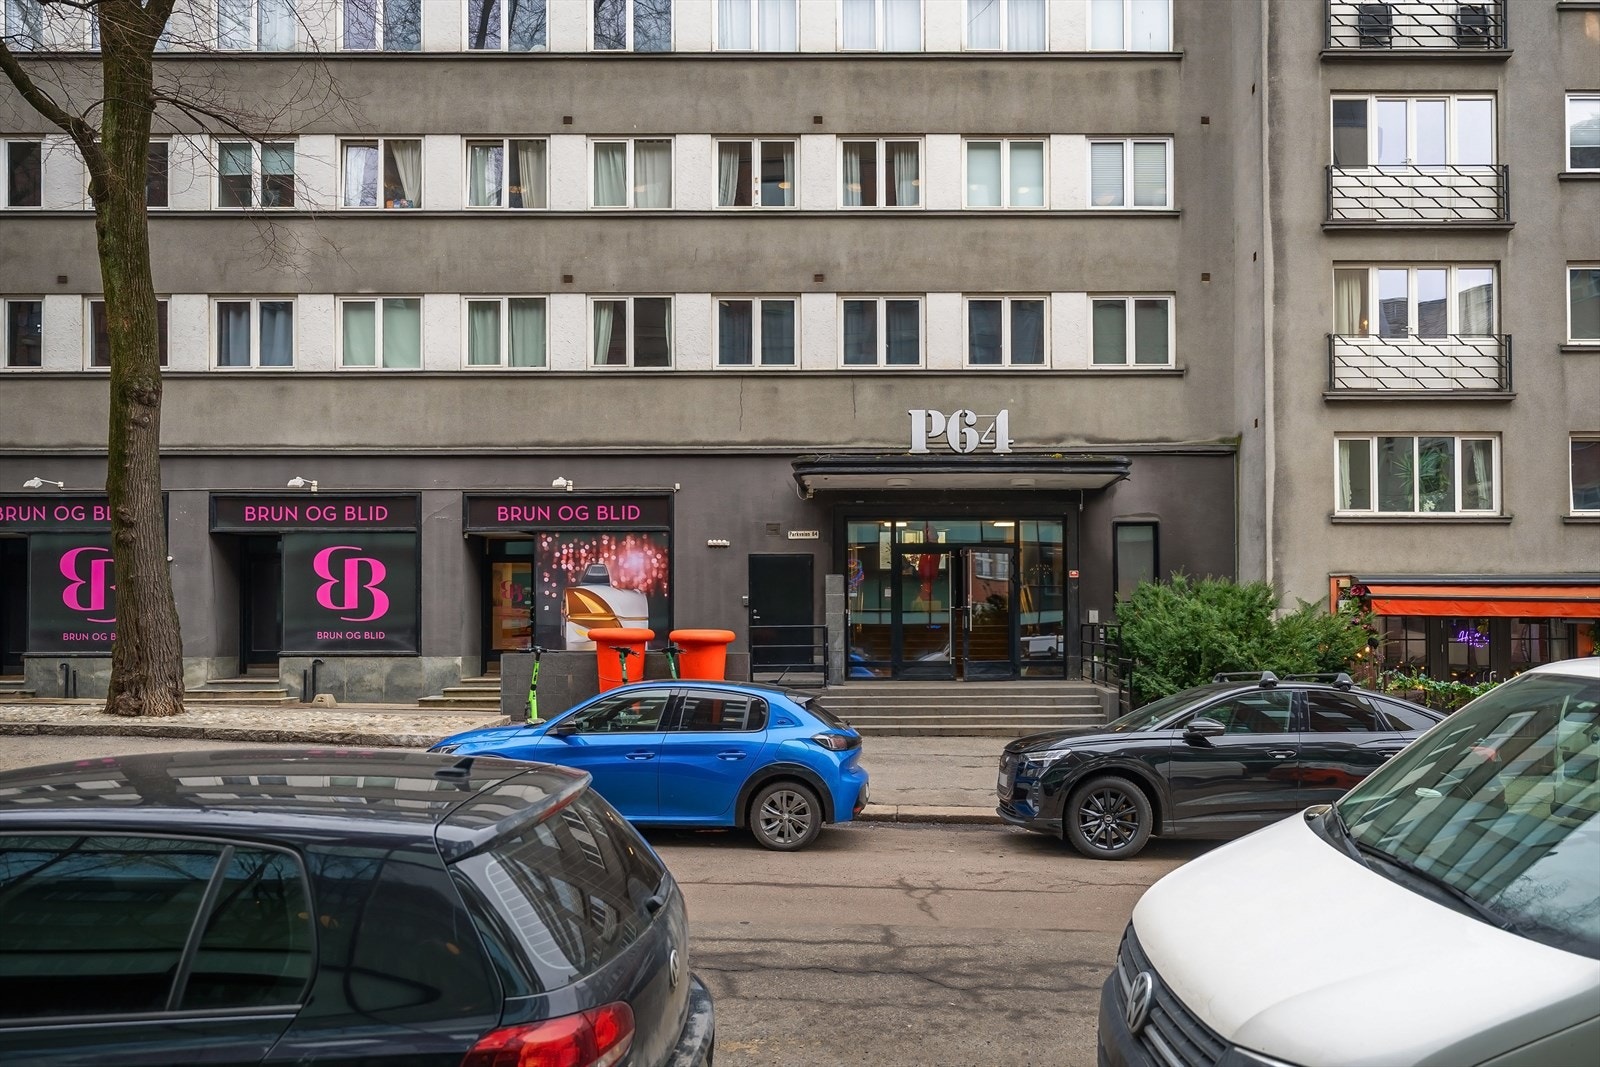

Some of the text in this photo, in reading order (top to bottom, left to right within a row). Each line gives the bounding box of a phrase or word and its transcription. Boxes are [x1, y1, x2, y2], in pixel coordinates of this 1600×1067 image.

[908, 409, 1014, 454] P64
[54, 505, 85, 521] OG
[93, 505, 112, 521] BL
[244, 505, 388, 522] BRUN OG BLID
[497, 504, 640, 522] BRUN OG BLID
